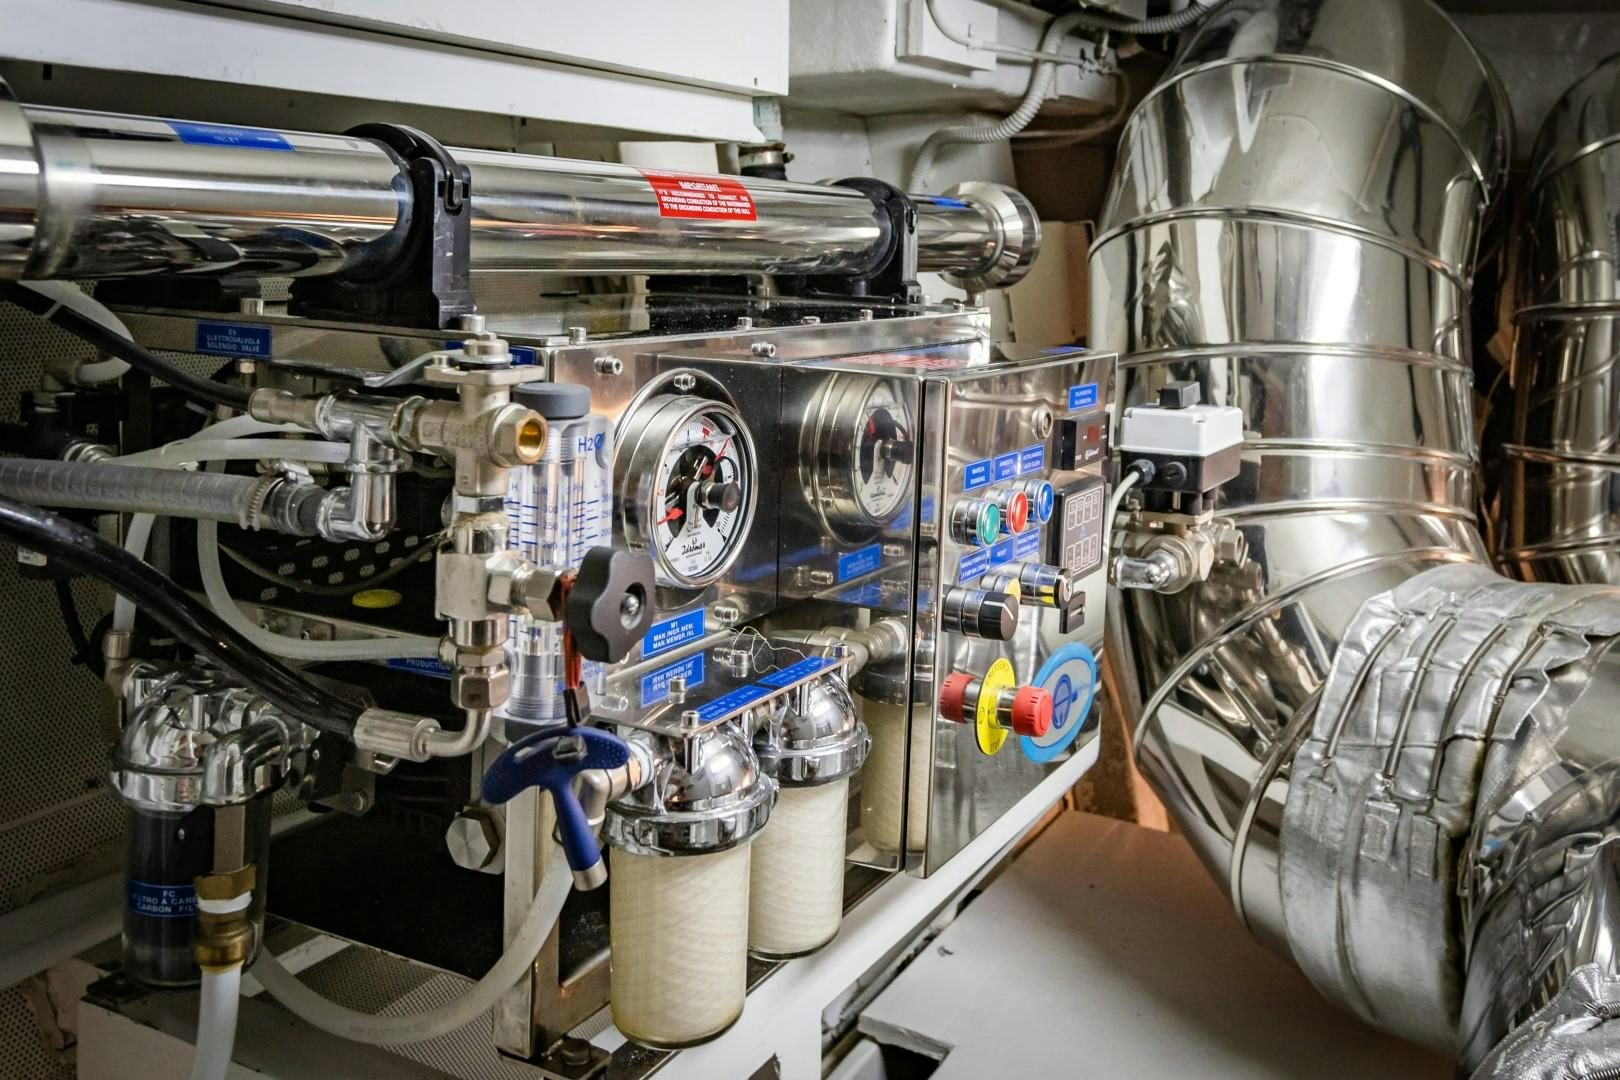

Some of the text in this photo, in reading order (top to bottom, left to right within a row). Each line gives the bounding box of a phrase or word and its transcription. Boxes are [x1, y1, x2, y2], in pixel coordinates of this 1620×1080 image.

[241, 344, 260, 353] VALVE
[162, 890, 176, 898] FC
[137, 902, 172, 913] CARBON
